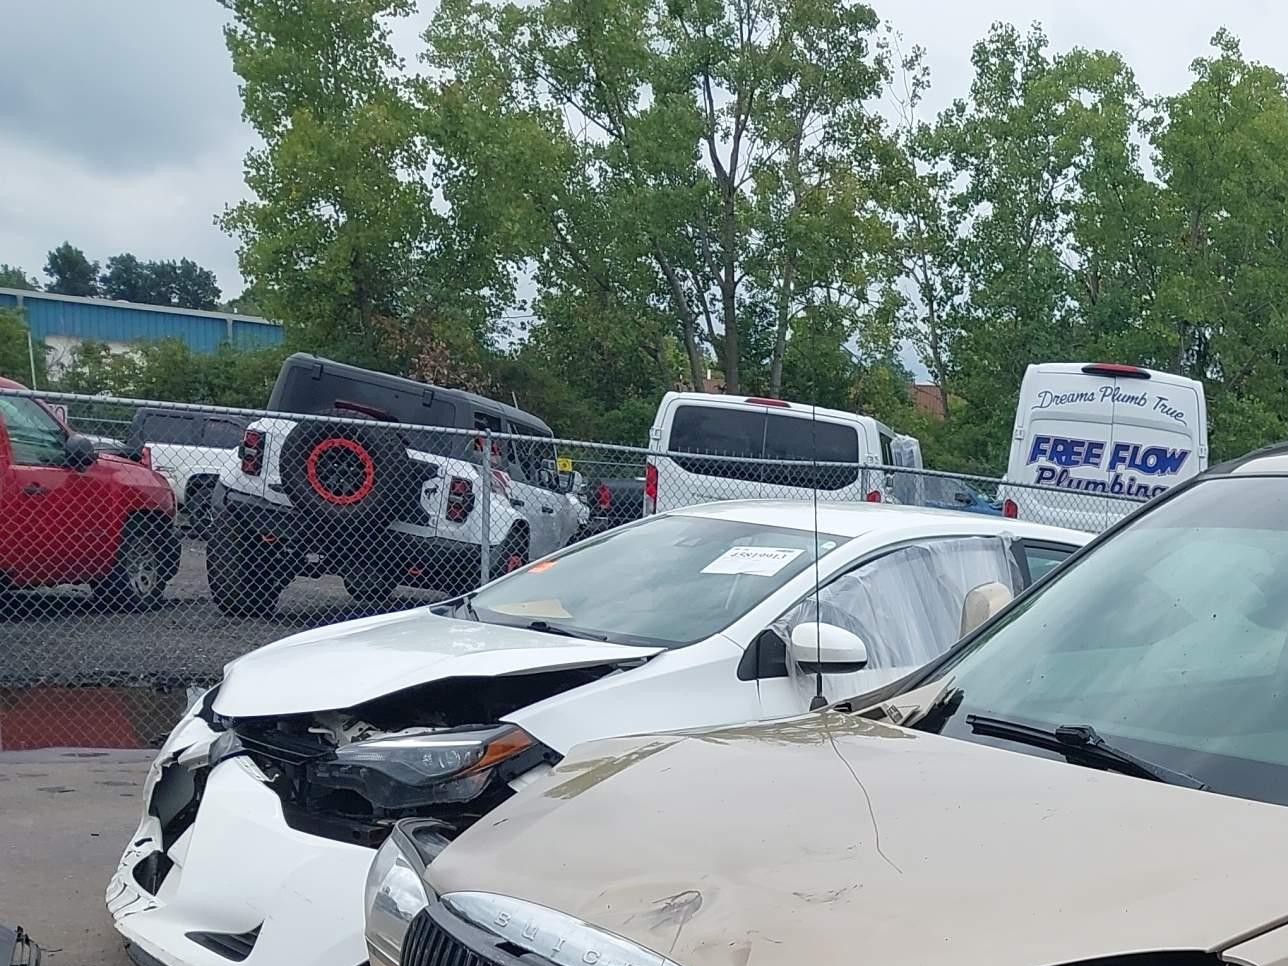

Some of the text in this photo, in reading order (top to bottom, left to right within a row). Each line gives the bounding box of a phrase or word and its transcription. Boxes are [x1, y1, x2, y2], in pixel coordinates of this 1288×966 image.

[1031, 386, 1188, 427] Dreams Plumb True
[1026, 434, 1192, 476] FREE FLOW
